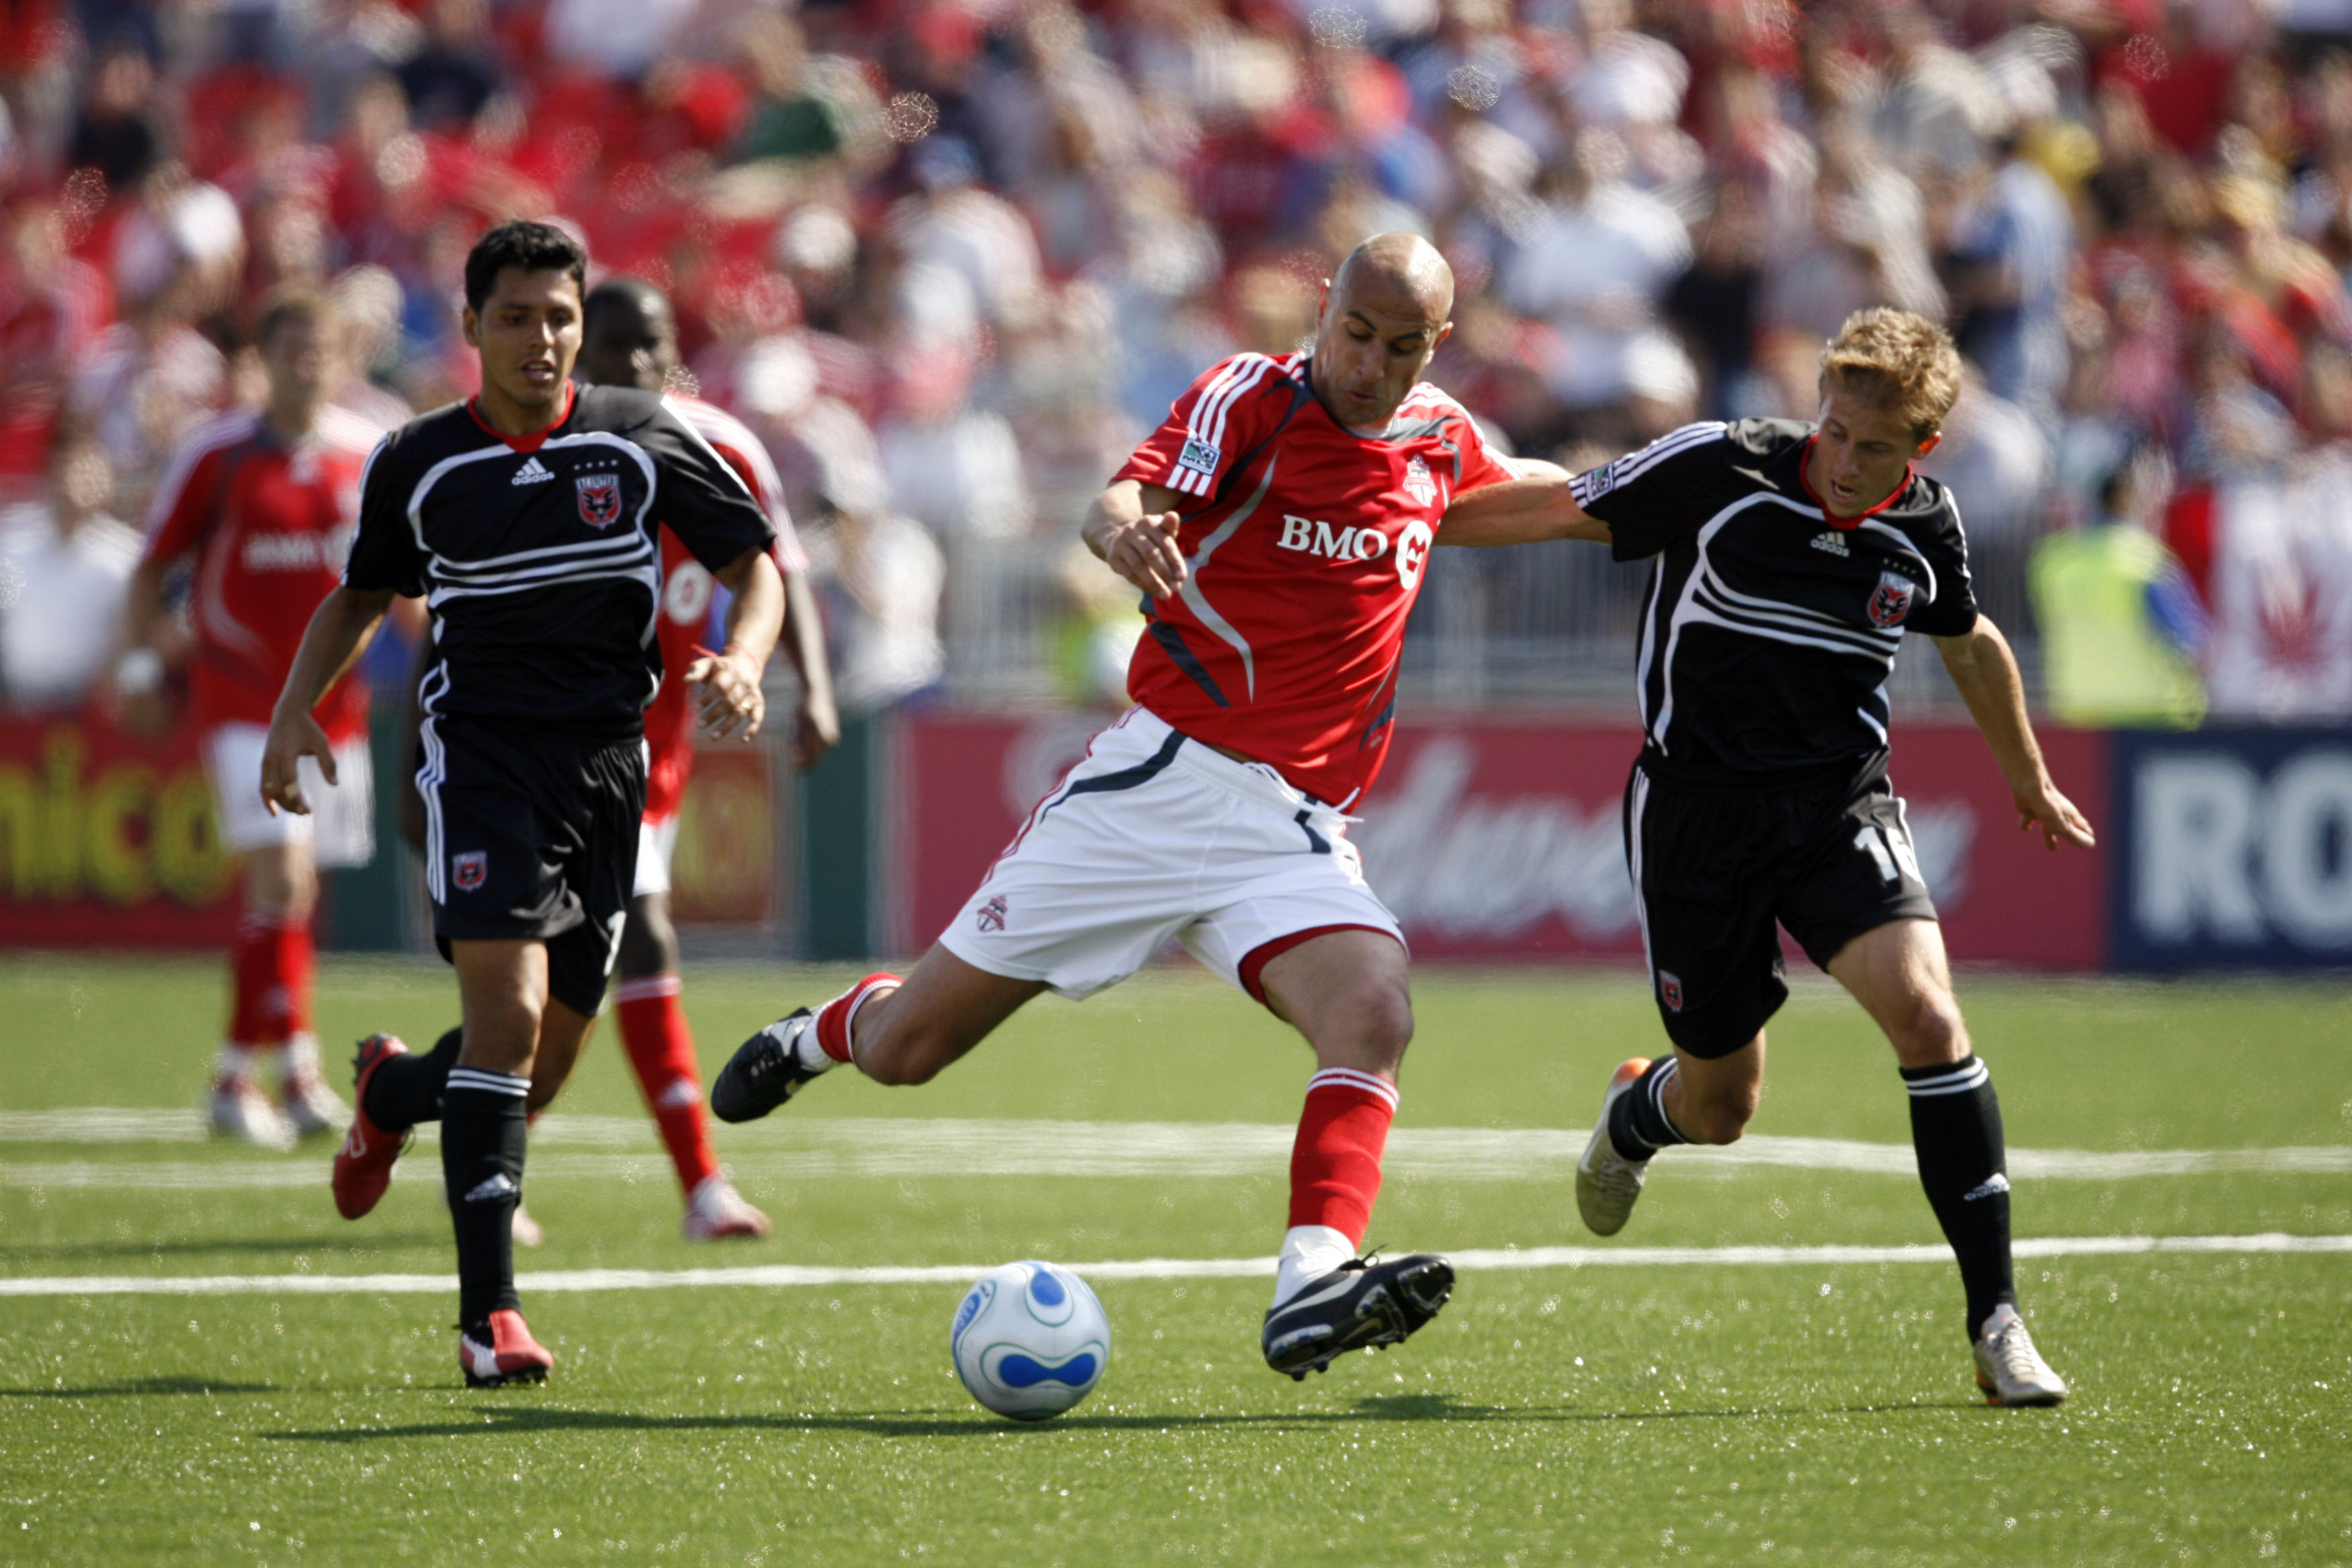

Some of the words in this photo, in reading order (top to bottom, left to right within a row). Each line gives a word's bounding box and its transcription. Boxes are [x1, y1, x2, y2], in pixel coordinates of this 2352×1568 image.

[511, 471, 555, 486] adidas
[1277, 514, 1388, 560] BMO
[1810, 538, 1850, 558] adidas
